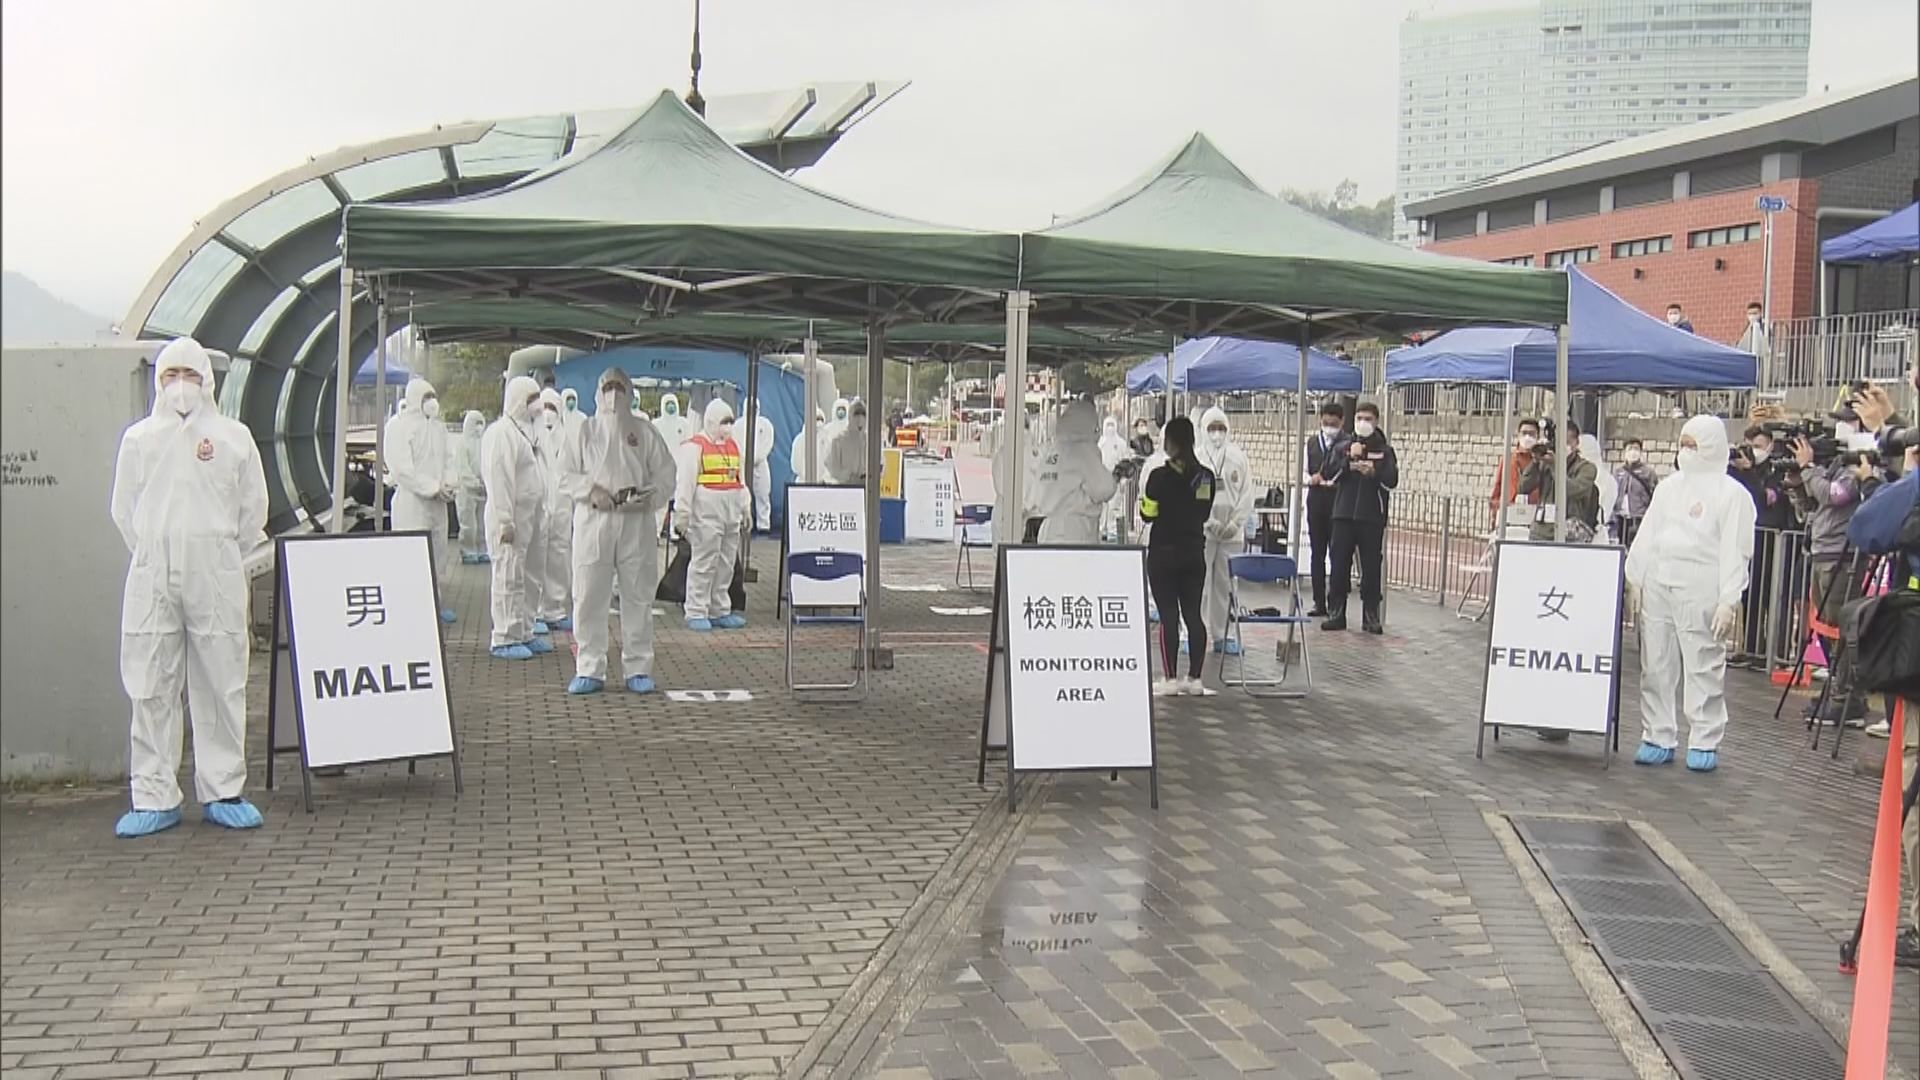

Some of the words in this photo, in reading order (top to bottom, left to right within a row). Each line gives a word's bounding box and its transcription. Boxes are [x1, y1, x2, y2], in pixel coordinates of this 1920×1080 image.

[798, 512, 858, 531] 乾洗區
[346, 585, 386, 627] 男
[1023, 596, 1130, 630] 檢驗區
[1537, 586, 1573, 620] 女
[1020, 658, 1138, 671] MONITORING
[1491, 646, 1613, 675] FEMALE
[313, 662, 433, 699] MALE
[1056, 688, 1105, 701] AREA
